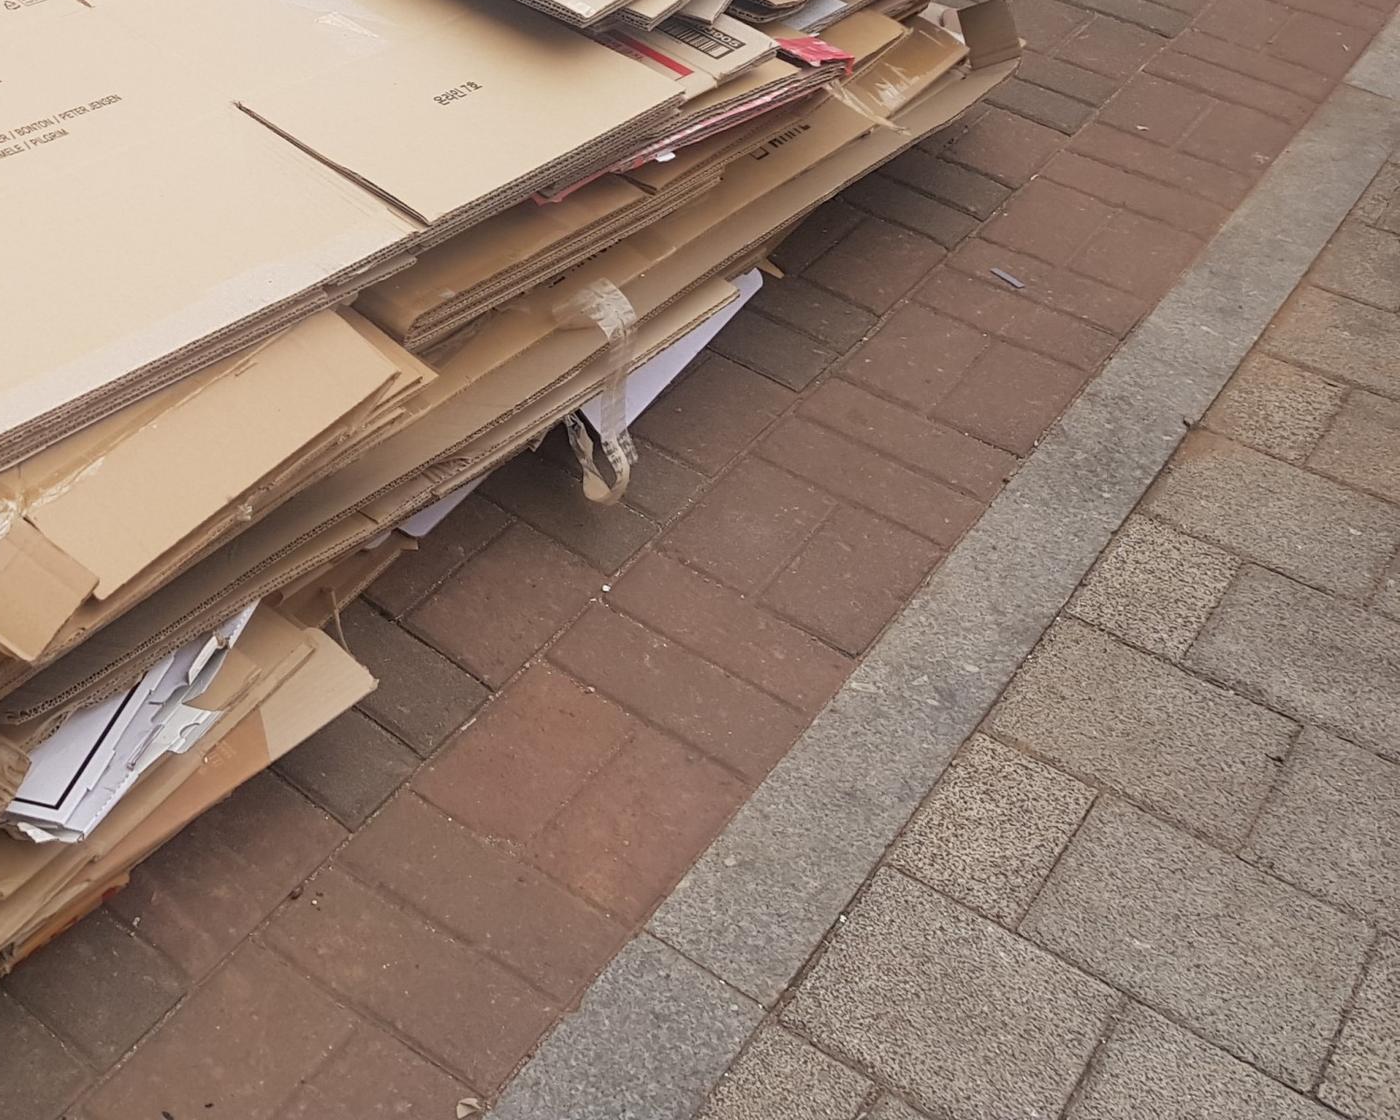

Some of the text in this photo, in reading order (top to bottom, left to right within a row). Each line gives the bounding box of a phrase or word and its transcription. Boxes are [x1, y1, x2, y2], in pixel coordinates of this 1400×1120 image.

[432, 81, 484, 107] 온라인 7호
[13, 117, 55, 137] BONTON
[58, 104, 91, 122] PETER
[88, 93, 123, 113] JENSEN
[28, 127, 71, 148] PILGRIM
